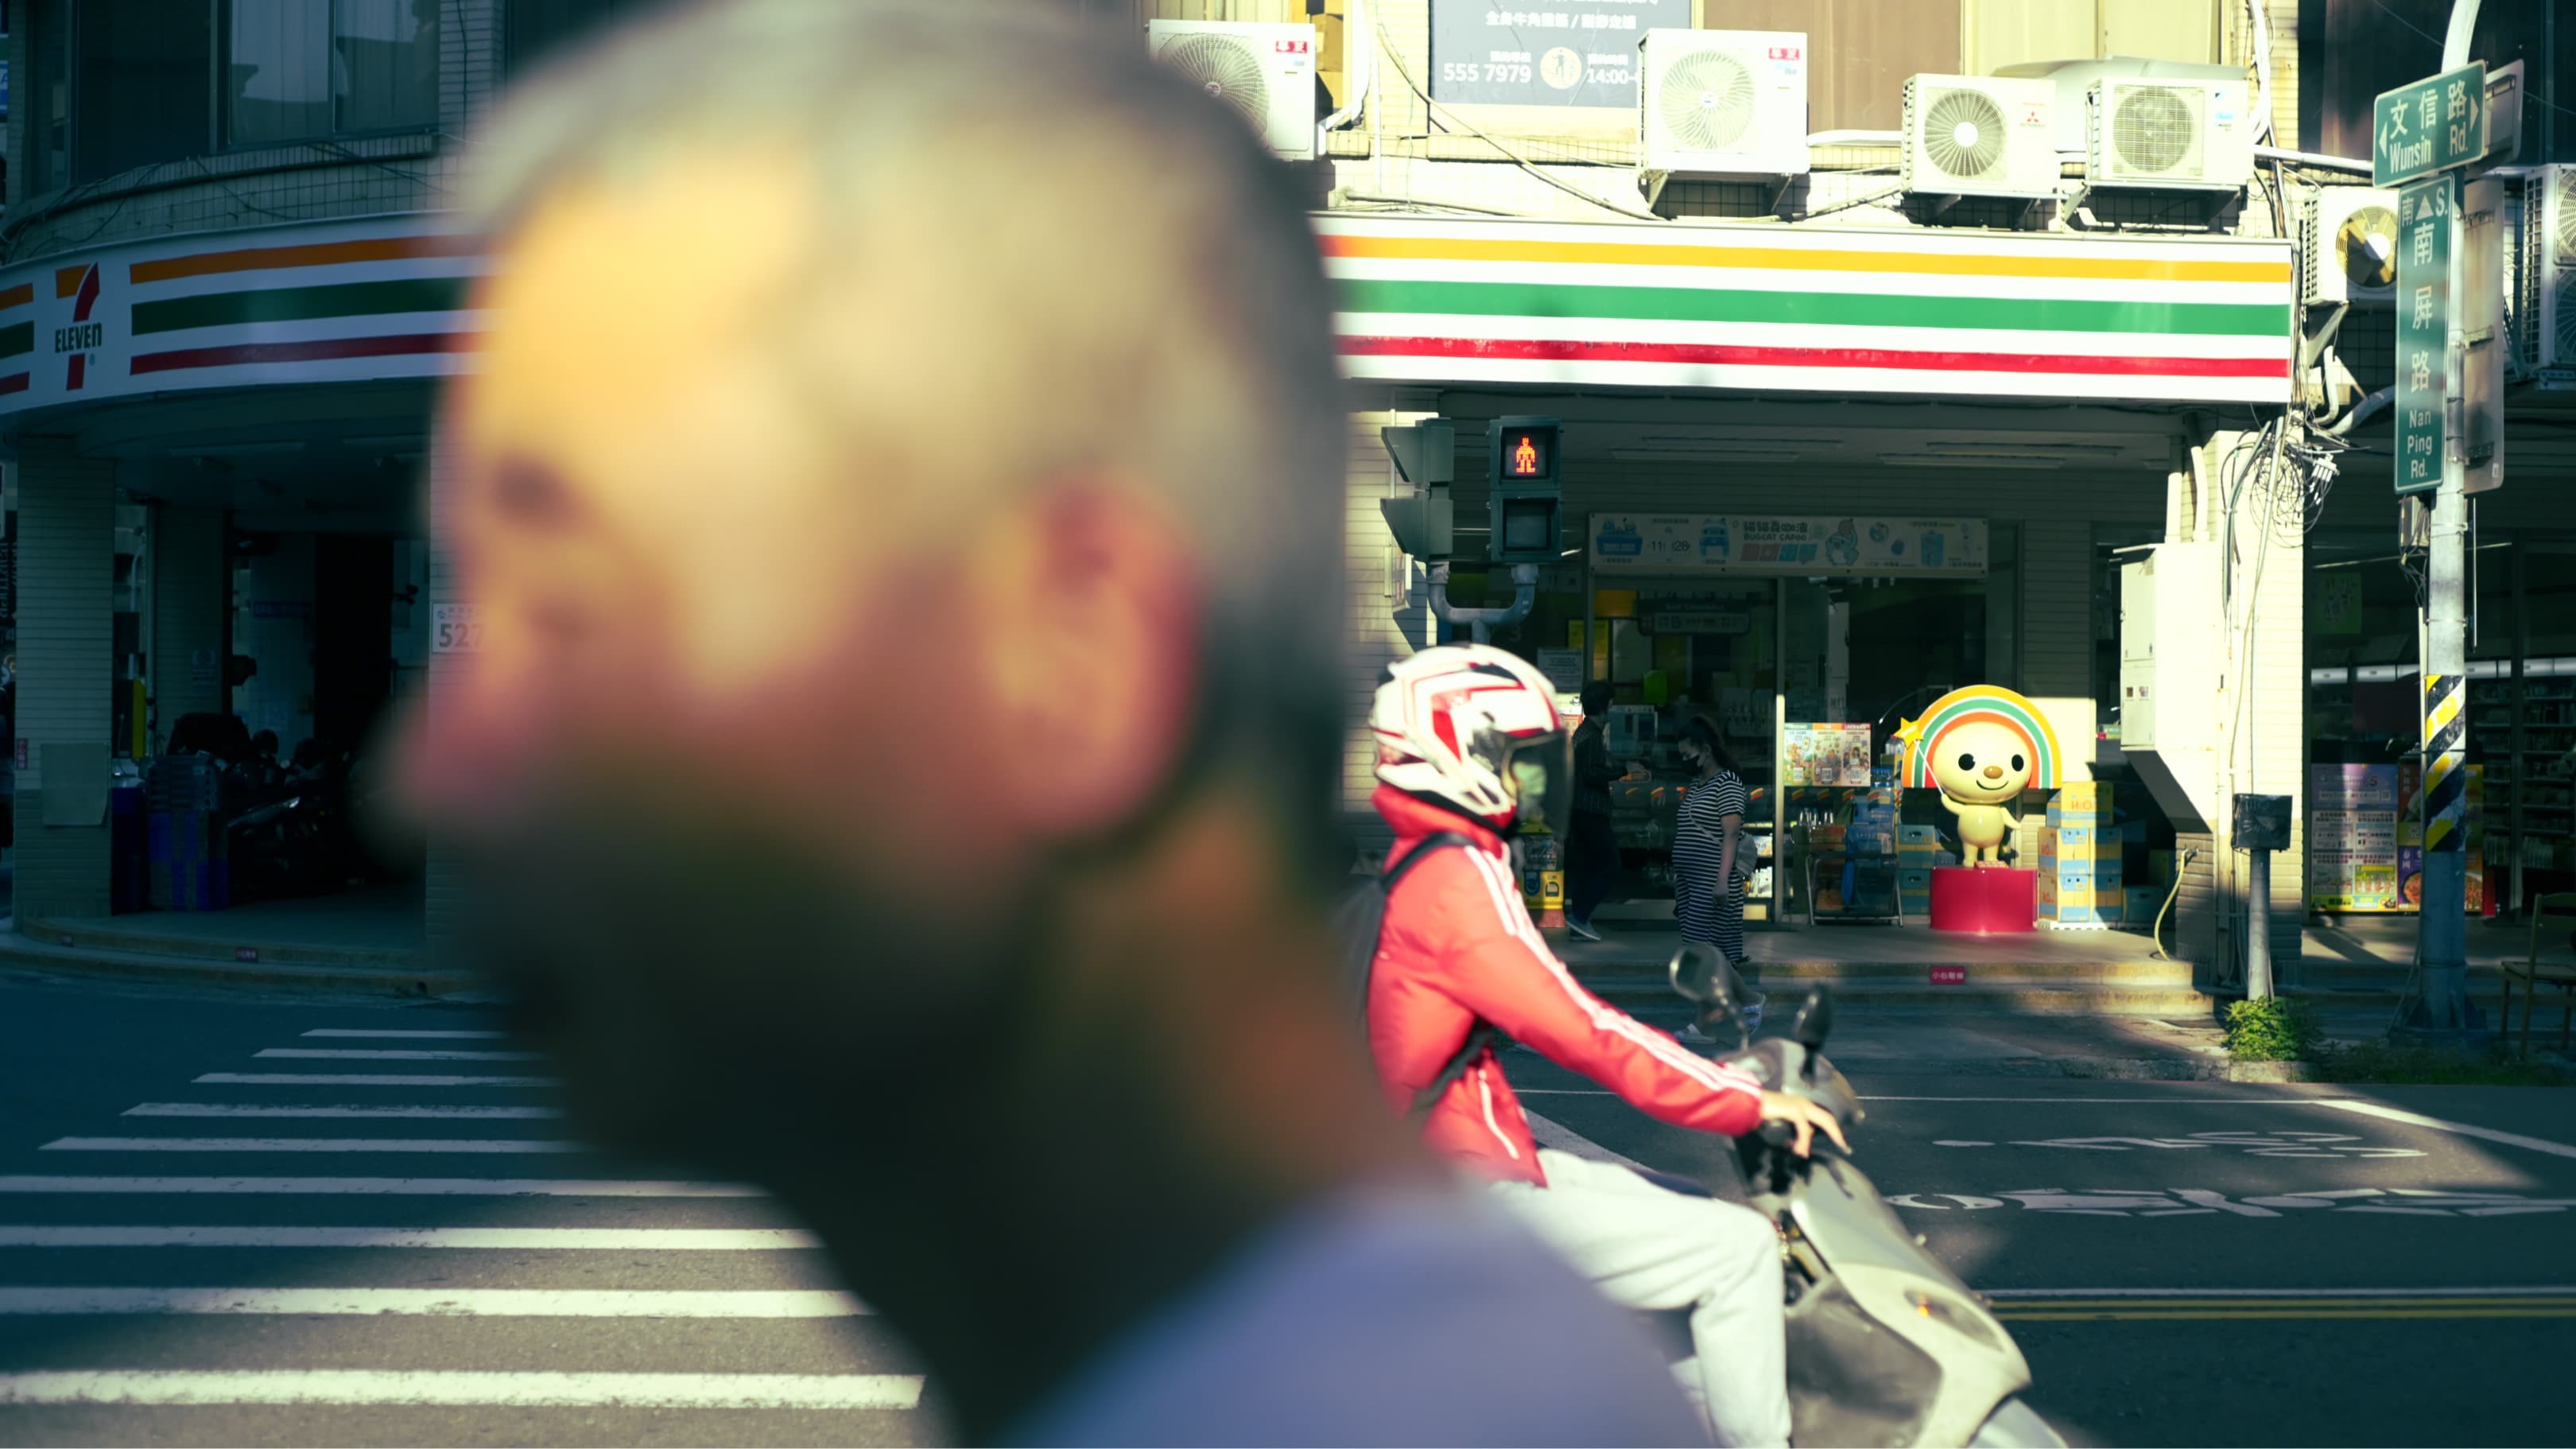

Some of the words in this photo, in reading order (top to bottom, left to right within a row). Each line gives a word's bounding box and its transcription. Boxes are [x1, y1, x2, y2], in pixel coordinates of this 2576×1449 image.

[1443, 64, 1479, 82] 555
[1484, 64, 1531, 84] 7979
[2390, 80, 2468, 140] 文信路
[2390, 136, 2431, 174] Wunsin
[2450, 122, 2469, 157] Rd.
[2401, 196, 2415, 227] 南
[2435, 185, 2449, 217] S.
[2410, 222, 2435, 394] 南屏路
[2409, 409, 2431, 429] Nan
[2407, 434, 2432, 456] Ping
[2411, 459, 2428, 479] Rd.
